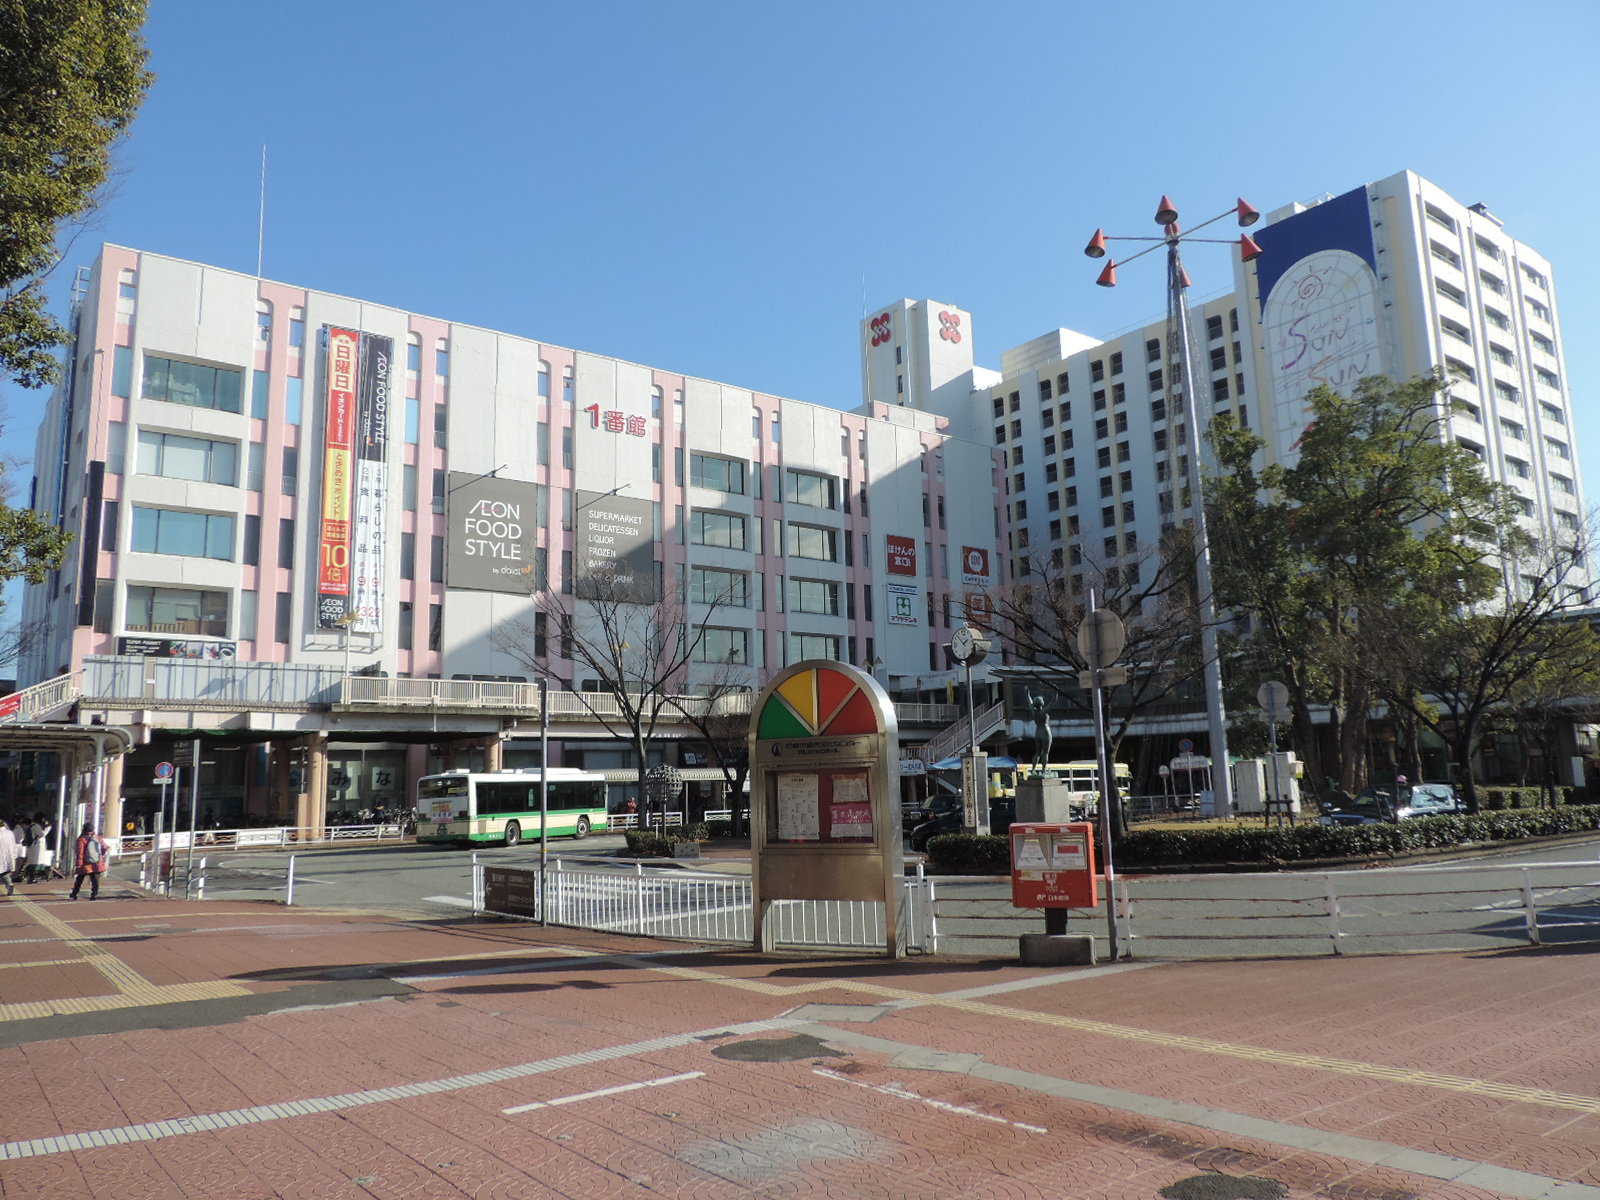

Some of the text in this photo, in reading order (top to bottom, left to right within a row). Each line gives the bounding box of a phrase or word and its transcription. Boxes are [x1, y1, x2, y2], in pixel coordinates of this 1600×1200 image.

[334, 345, 351, 390] 日曜日
[376, 381, 387, 411] FOOD
[587, 403, 647, 437] 1番館
[375, 413, 386, 444] STYLE
[588, 510, 643, 525] SUPERMARKET
[465, 518, 522, 540] FOOD
[588, 522, 640, 536] DELICATESSEN
[588, 534, 614, 545] LIQUOR
[322, 543, 349, 567] 10
[464, 538, 522, 561] STYLE
[588, 546, 616, 558] FROZEN
[888, 544, 916, 556] ほけんの
[327, 567, 342, 582] 倍
[321, 605, 344, 614] FOOD
[891, 615, 918, 623] マツヤデンキ
